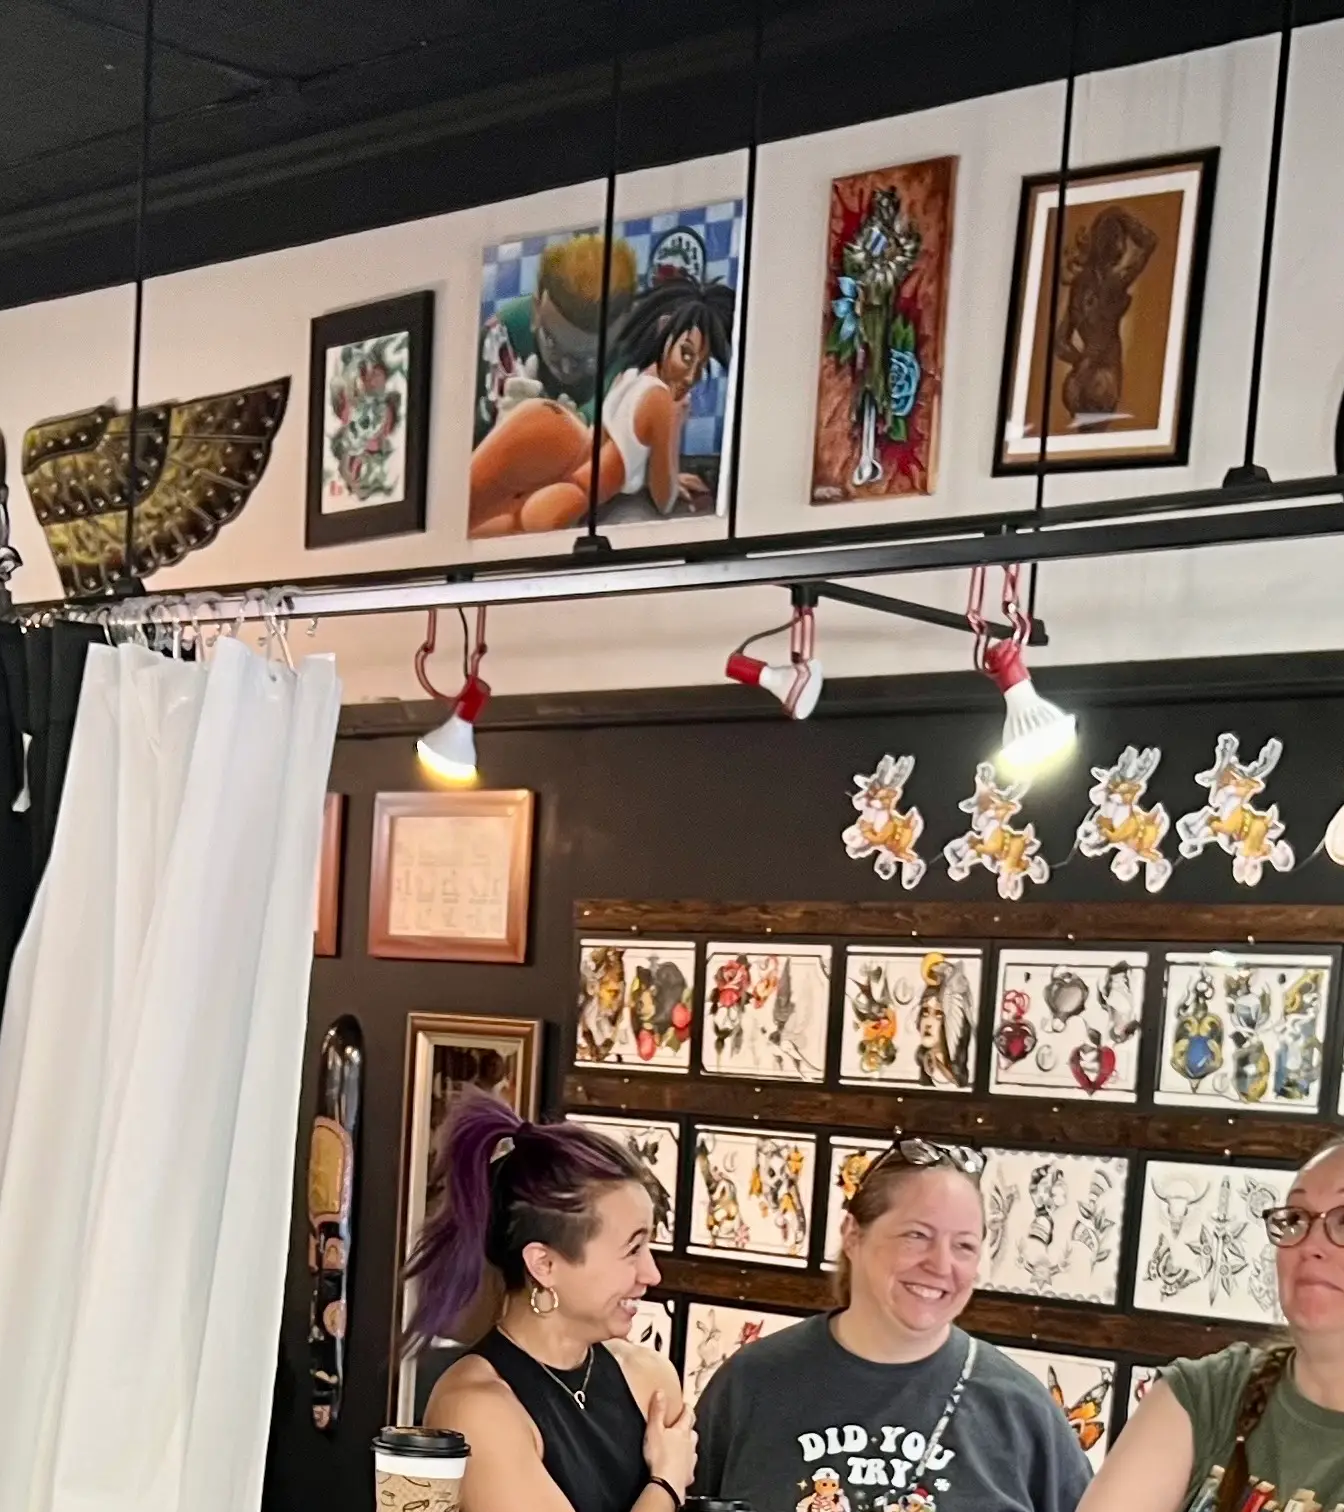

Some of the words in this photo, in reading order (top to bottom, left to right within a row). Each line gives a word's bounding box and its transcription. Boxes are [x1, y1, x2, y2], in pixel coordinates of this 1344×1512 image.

[797, 1424, 869, 1462] DID
[879, 1426, 956, 1471] YOU
[847, 1456, 913, 1488] TRY
